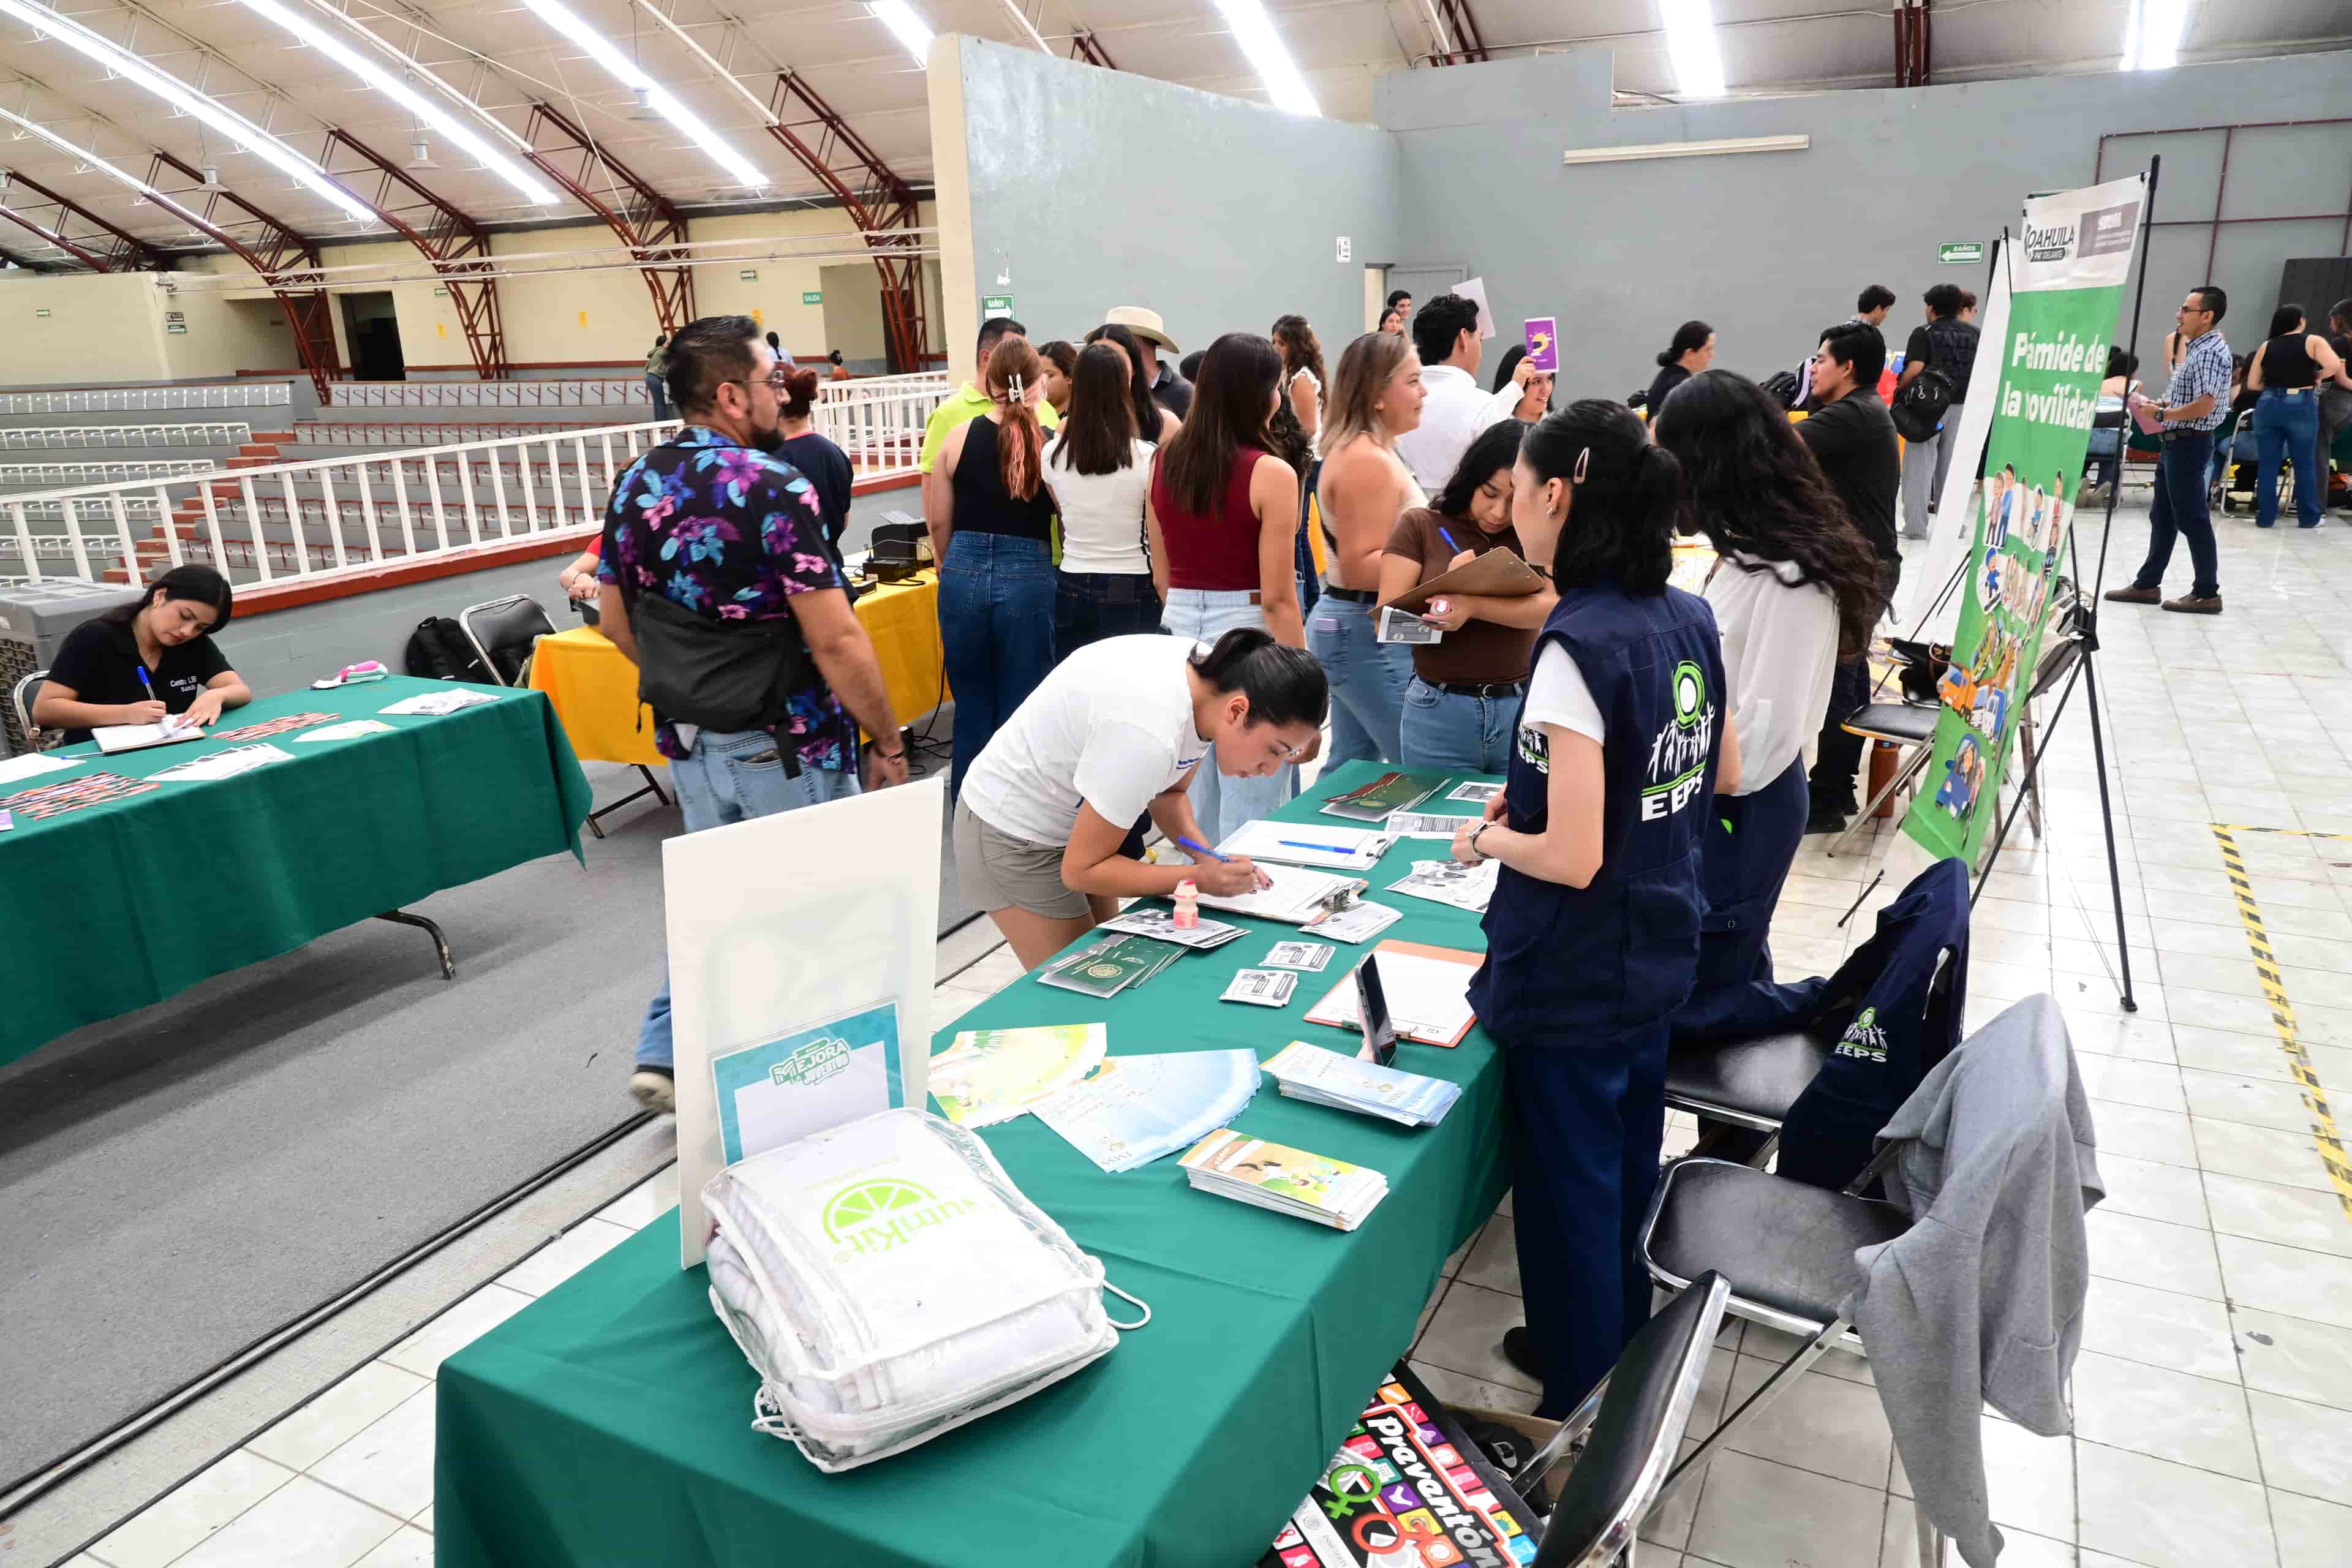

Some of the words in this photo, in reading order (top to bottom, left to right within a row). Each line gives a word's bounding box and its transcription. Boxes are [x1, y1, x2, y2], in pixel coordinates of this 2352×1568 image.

[988, 298, 1005, 307] BAÑOS
[2084, 333, 2105, 373] de
[2001, 380, 2022, 417] la
[771, 1040, 850, 1085] MEJORA
[1835, 1043, 1888, 1063] EEPS
[1366, 1415, 1502, 1568] Preventón
